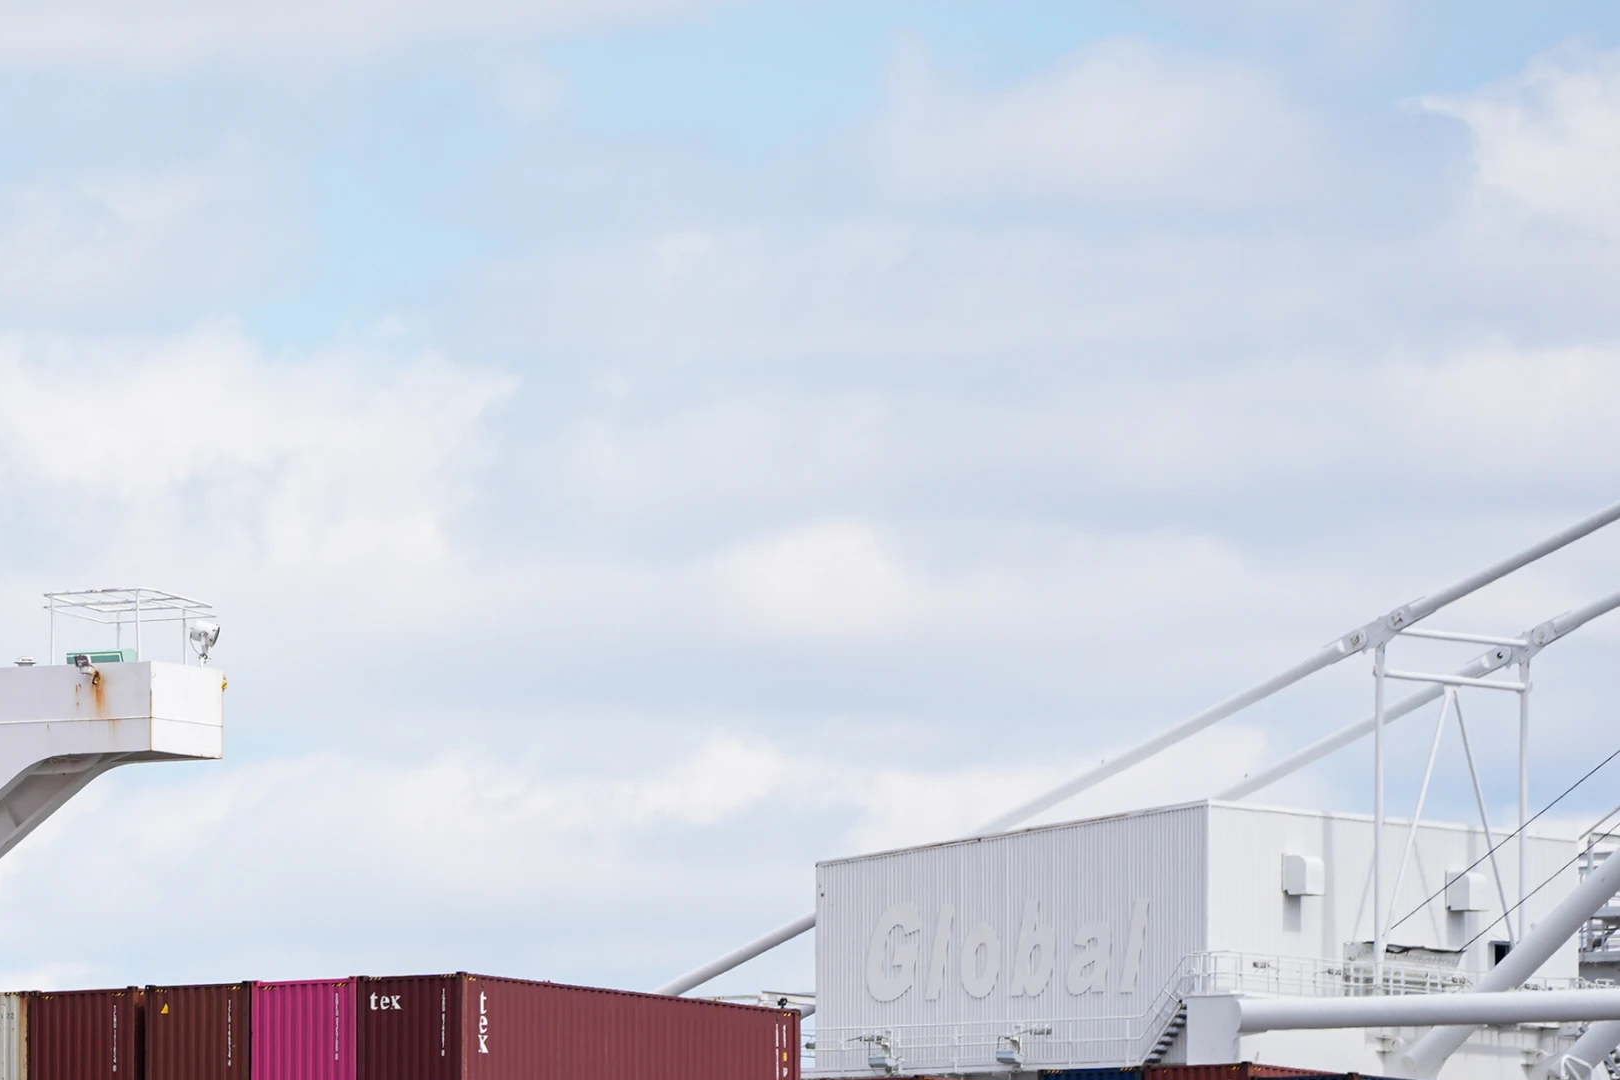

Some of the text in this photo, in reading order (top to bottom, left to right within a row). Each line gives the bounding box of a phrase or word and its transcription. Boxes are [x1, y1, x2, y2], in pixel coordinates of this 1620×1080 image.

[866, 899, 1150, 1002] Global
[369, 992, 402, 1011] tex
[477, 991, 489, 1054] tex
